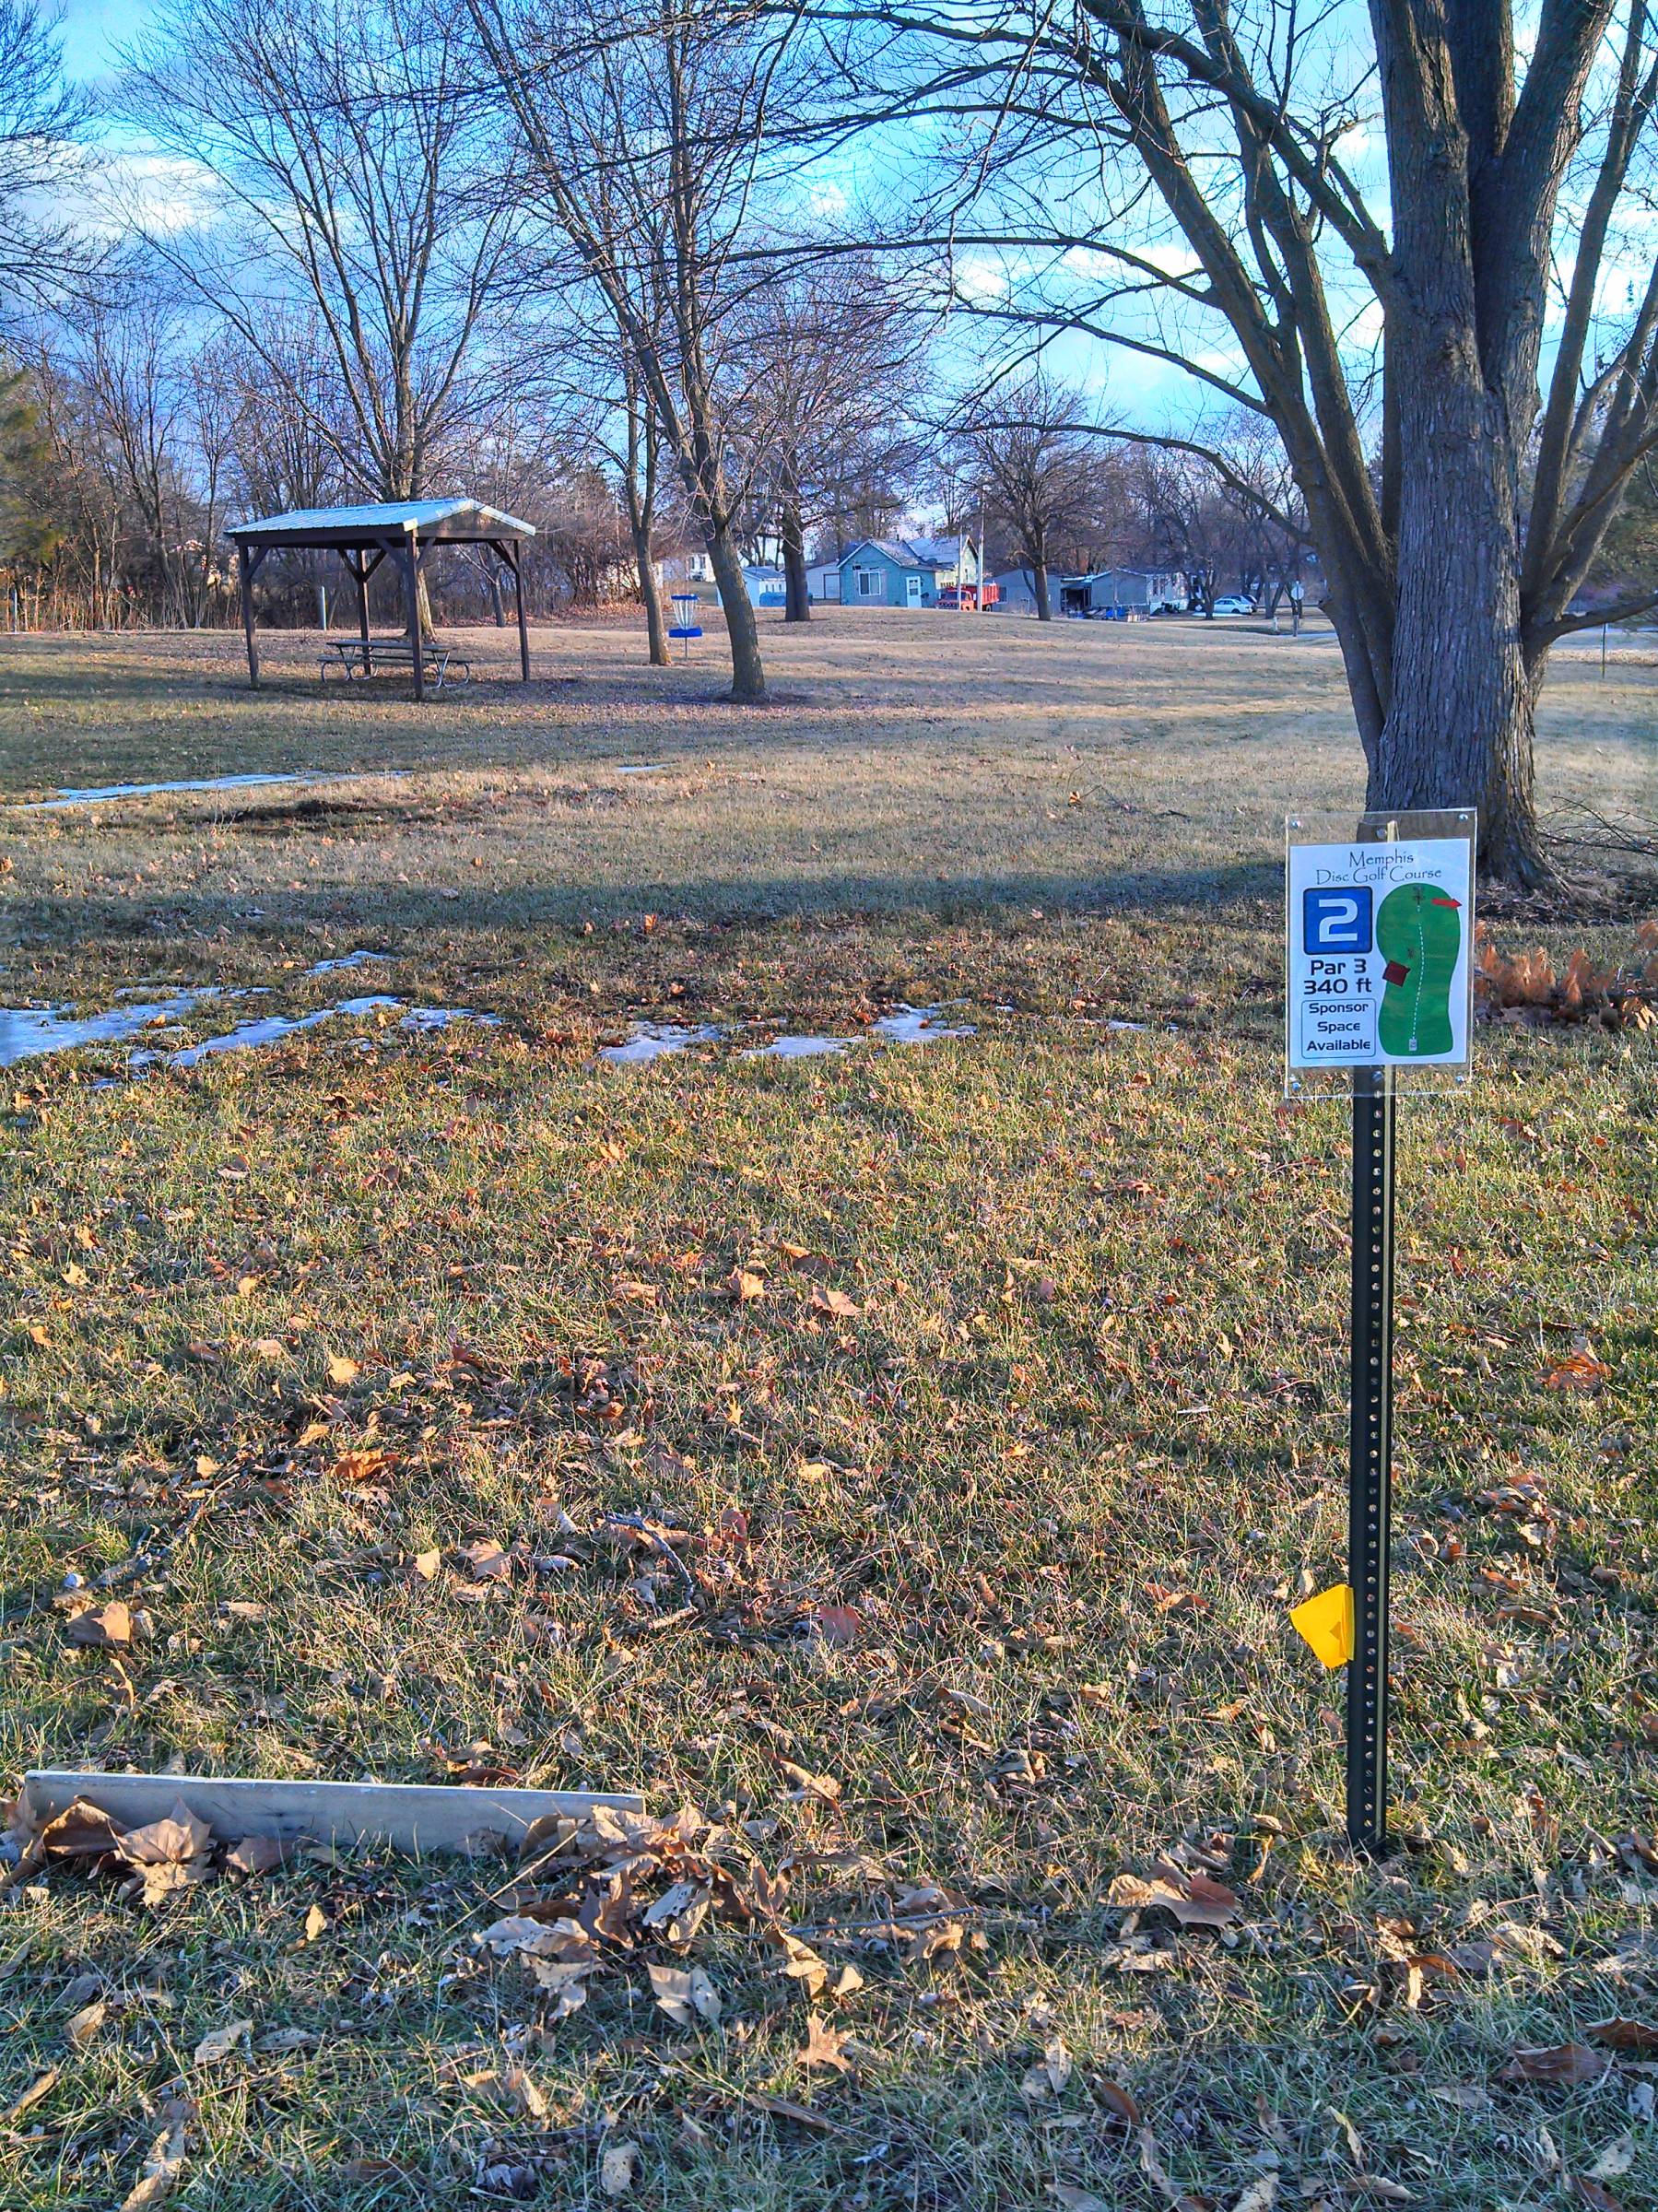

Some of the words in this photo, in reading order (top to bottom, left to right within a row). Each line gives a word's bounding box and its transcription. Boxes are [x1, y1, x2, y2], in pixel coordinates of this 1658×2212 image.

[1349, 848, 1414, 870] Memphis
[1316, 869, 1350, 885] Disc
[1353, 866, 1387, 884] Golf
[1389, 865, 1442, 883] Course
[1319, 898, 1358, 943] 2
[1311, 959, 1346, 976] Par
[1354, 959, 1367, 974] 3
[1303, 979, 1348, 995] 340
[1356, 978, 1372, 994] ft
[1309, 1002, 1369, 1016] Sponsor
[1317, 1021, 1360, 1034] Space
[1307, 1039, 1371, 1052] Available
